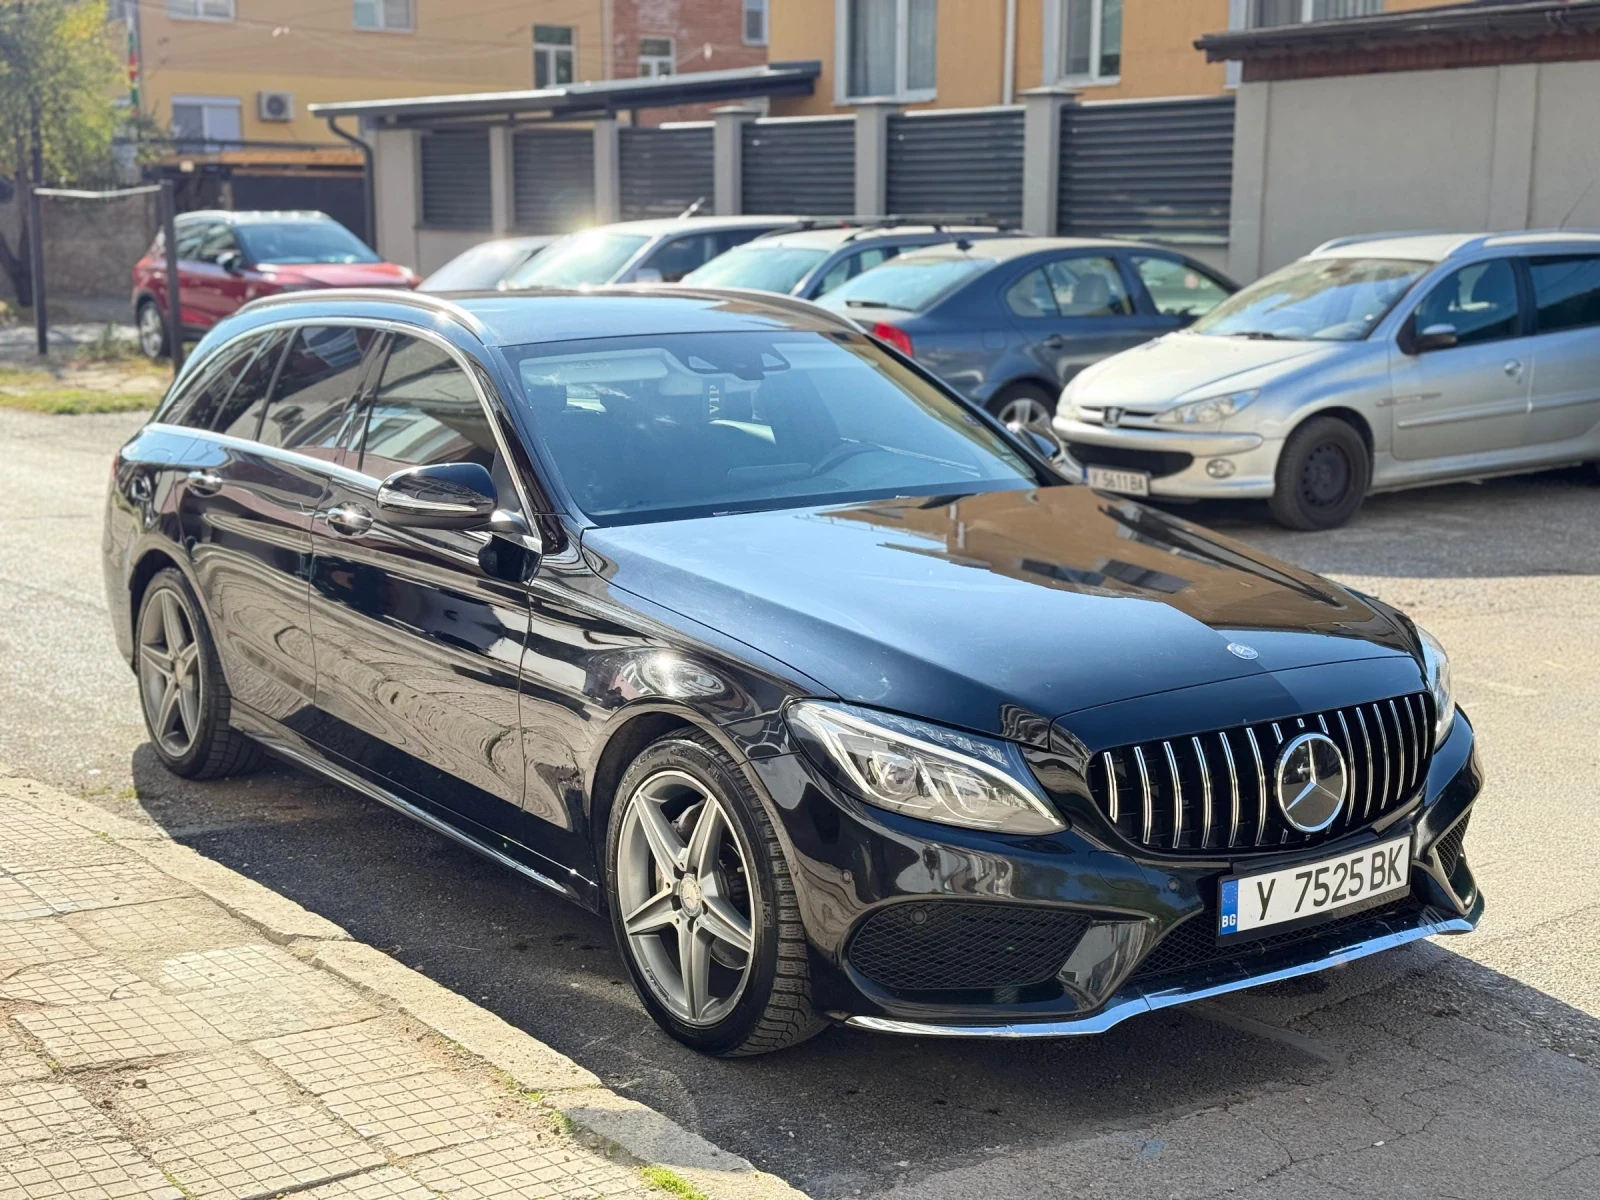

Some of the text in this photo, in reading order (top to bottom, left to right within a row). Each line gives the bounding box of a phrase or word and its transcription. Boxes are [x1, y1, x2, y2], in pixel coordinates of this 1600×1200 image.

[709, 384, 720, 415] VIP
[1256, 877, 1276, 922] Y
[1294, 856, 1365, 914] 7525
[1369, 843, 1405, 892] BK
[1221, 913, 1237, 928] BG
